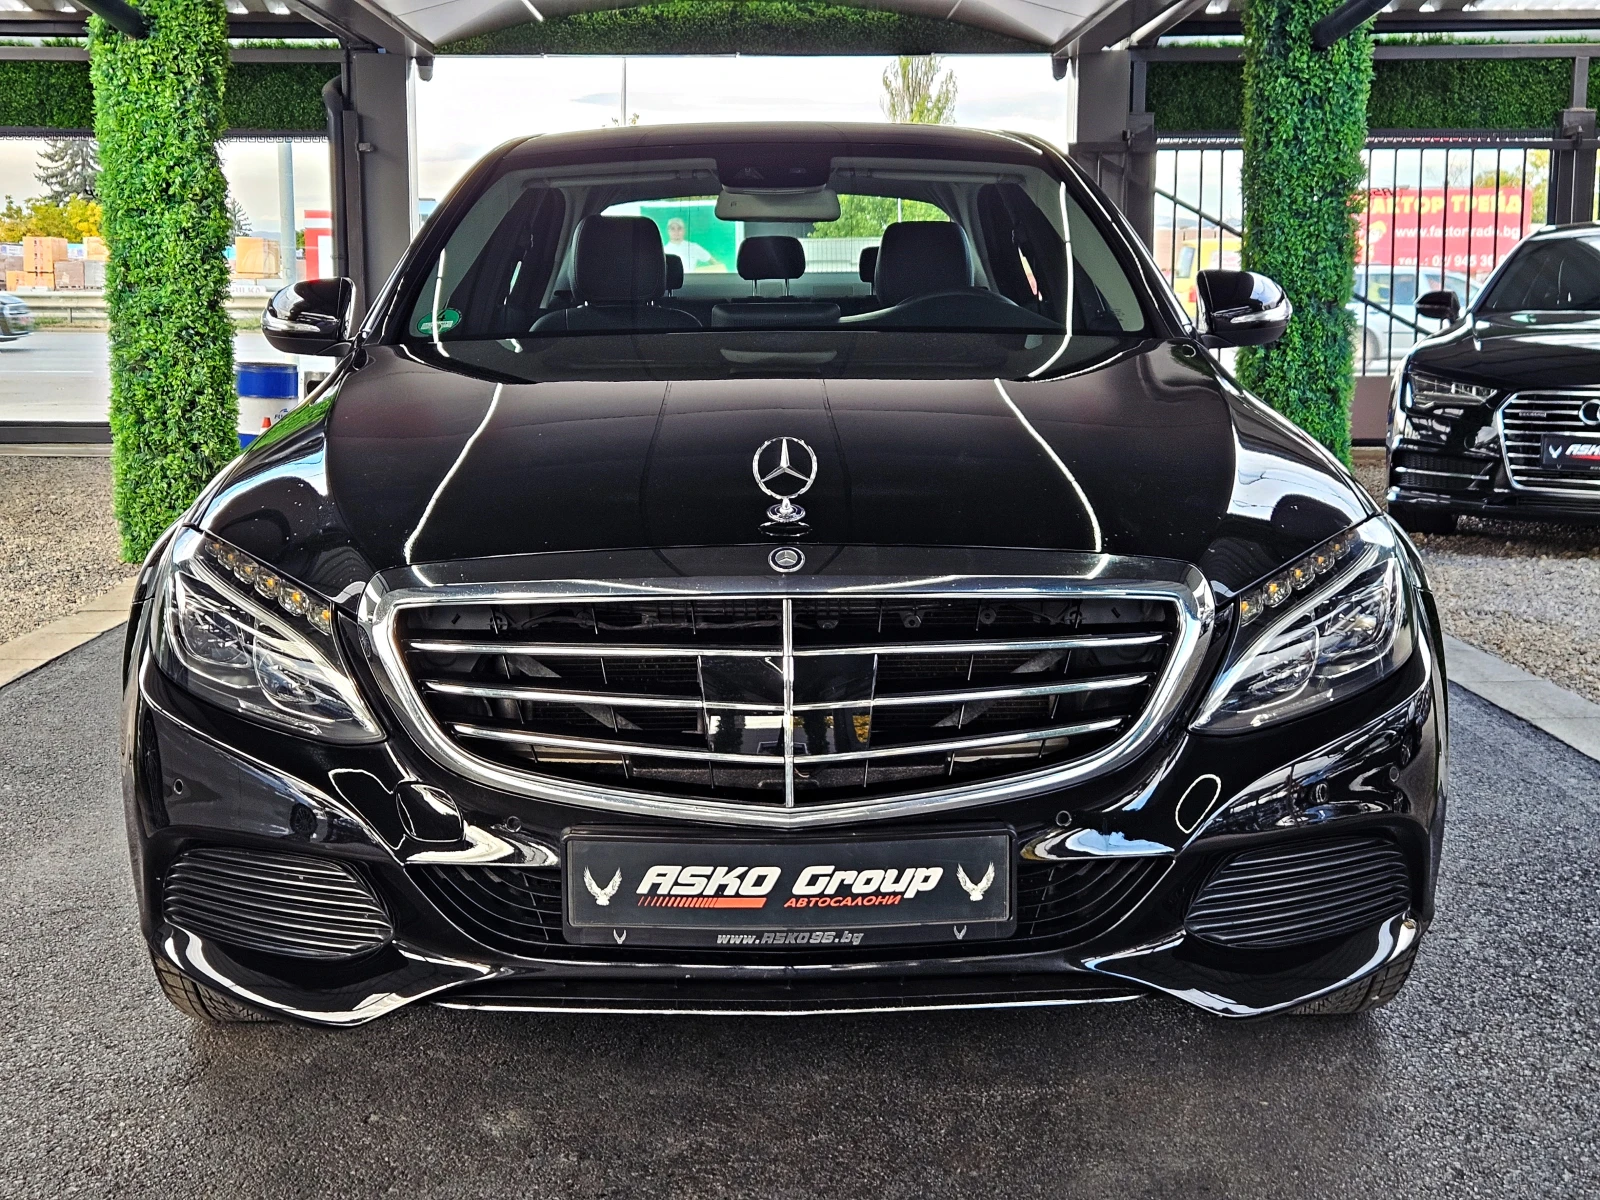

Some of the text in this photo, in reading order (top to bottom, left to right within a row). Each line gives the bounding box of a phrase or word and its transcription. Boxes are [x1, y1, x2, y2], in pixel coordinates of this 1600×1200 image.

[1360, 190, 1522, 214] АКТОР ТРЕЙД
[1395, 225, 1520, 240] www.fatorrad.bg
[635, 865, 944, 899] ASKO Group
[783, 894, 903, 908] АВТОСАЛОНИ
[716, 930, 865, 946] www.ASKO96.bg
